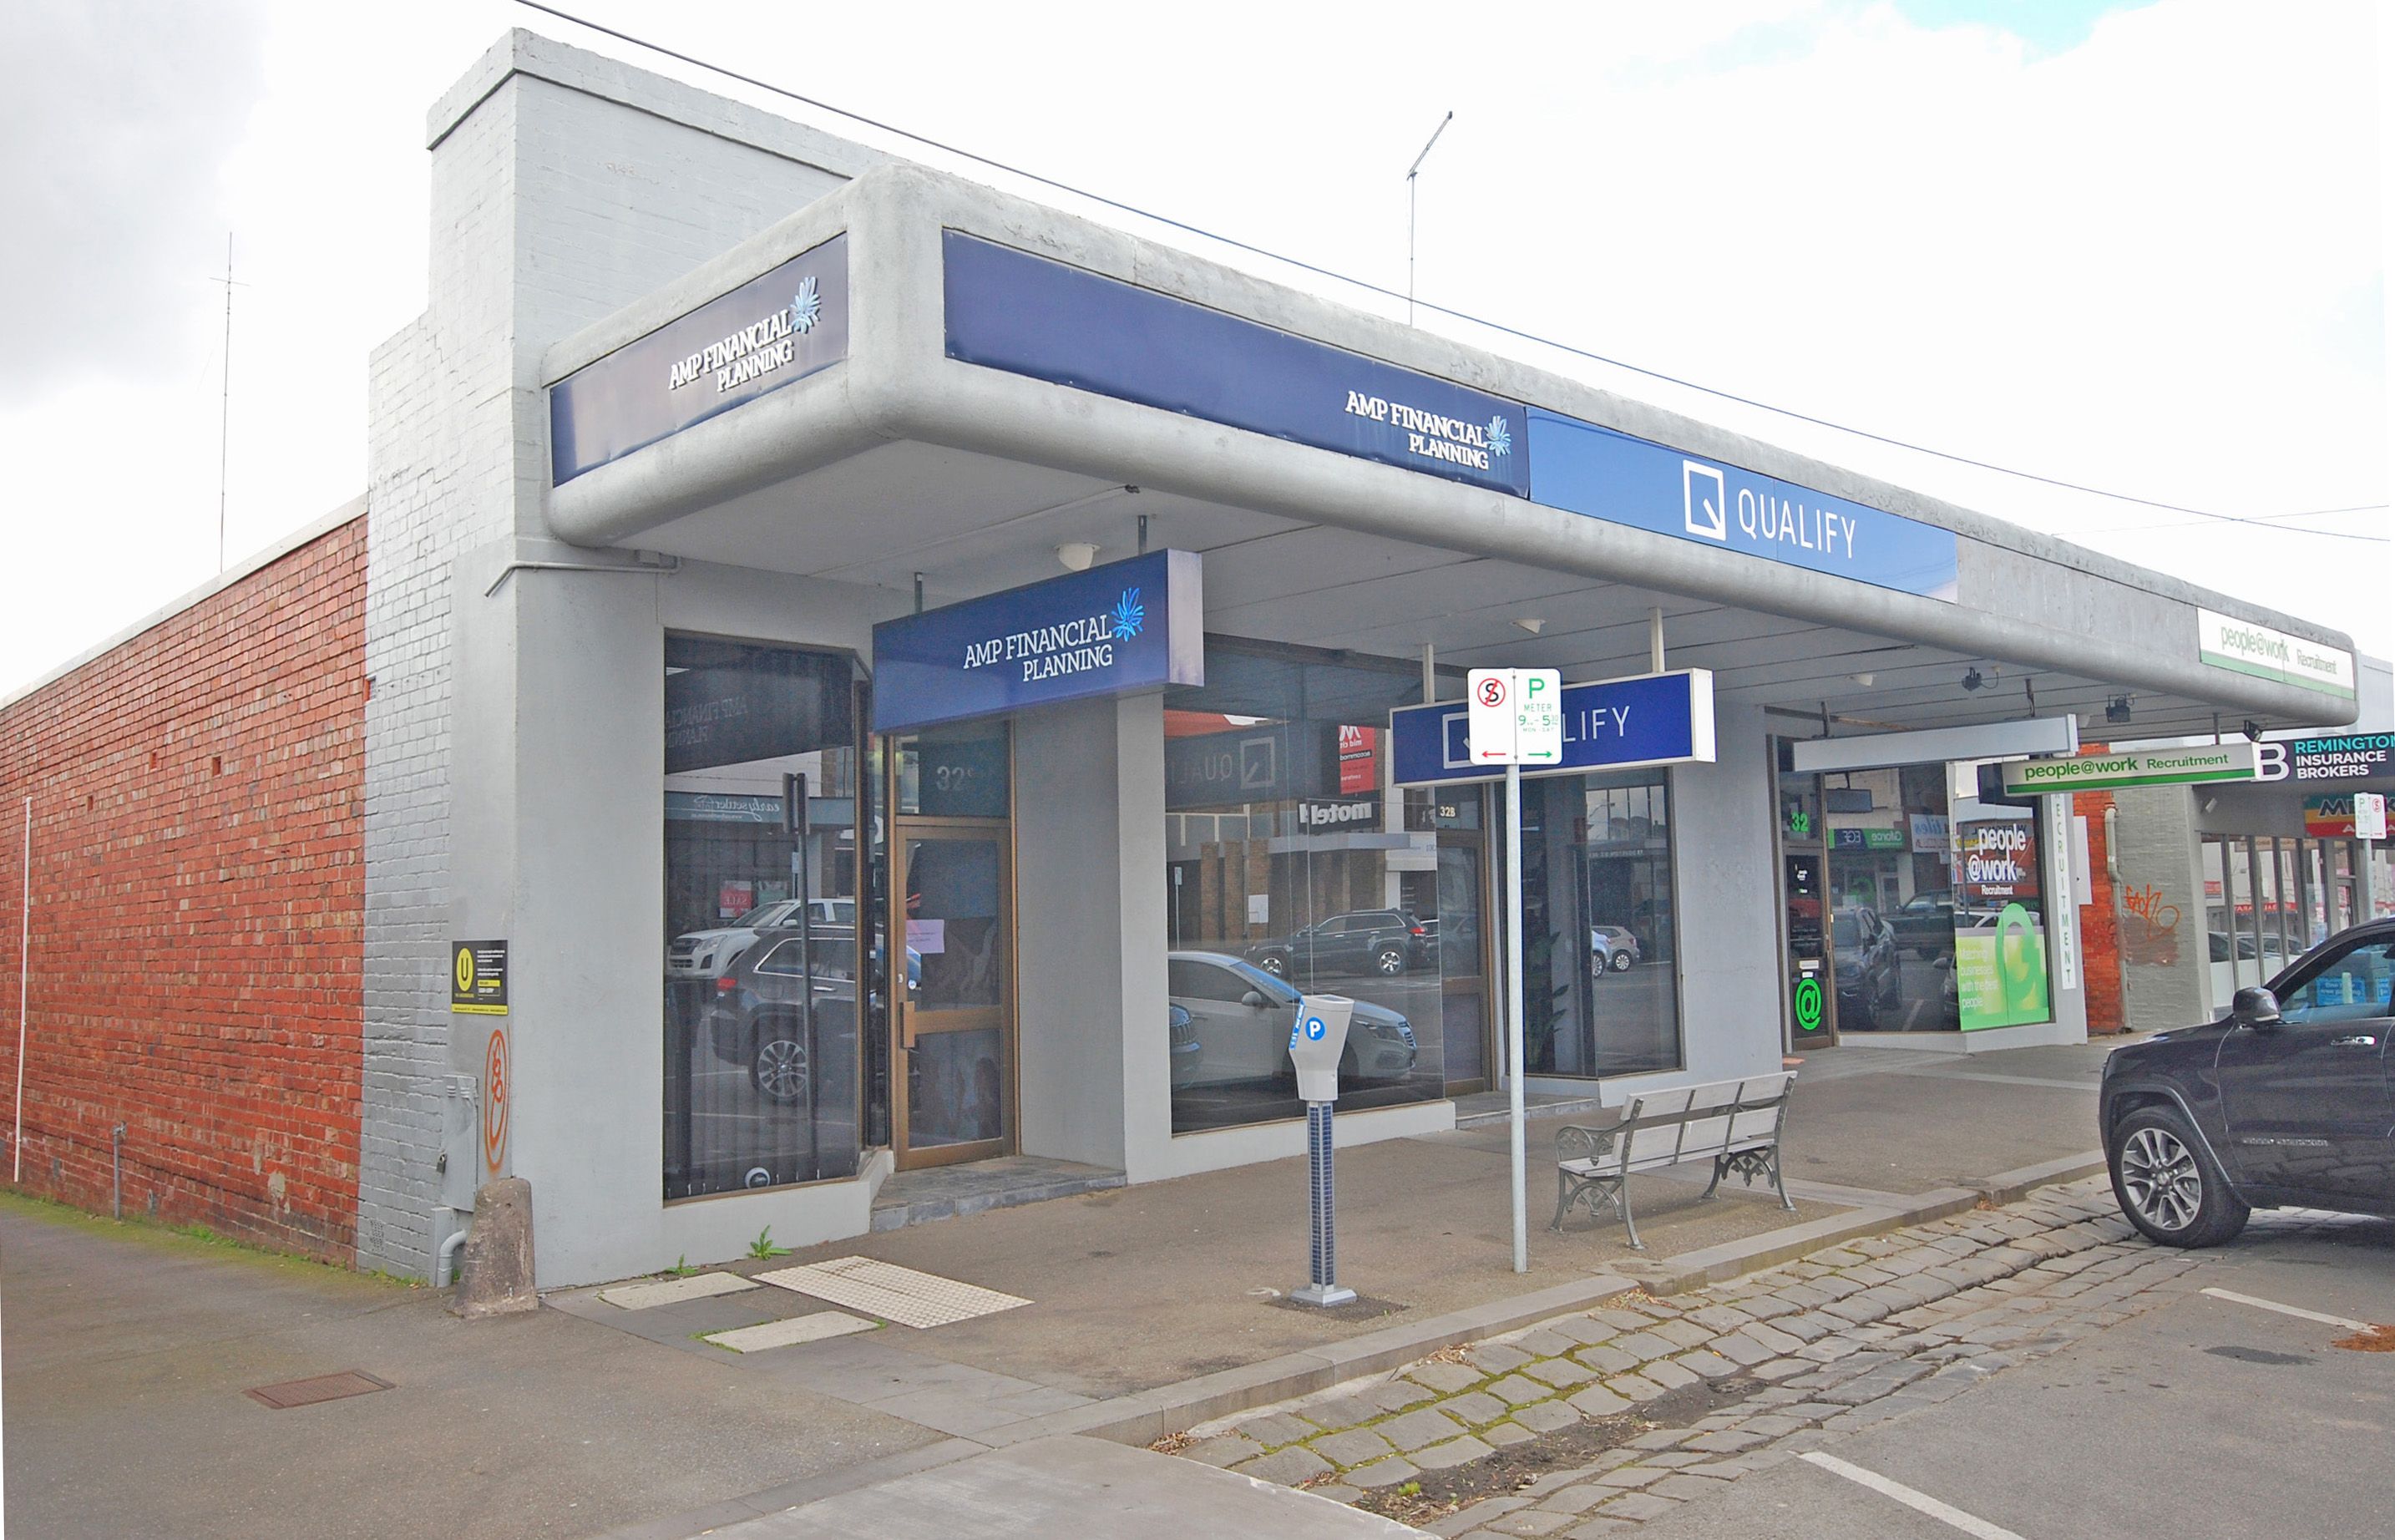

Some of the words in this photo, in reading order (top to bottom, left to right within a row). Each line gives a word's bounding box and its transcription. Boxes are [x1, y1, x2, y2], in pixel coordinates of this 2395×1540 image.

[668, 353, 703, 390] AMP
[702, 309, 792, 373] FINANCIAL
[716, 339, 793, 392] PLANNING
[1344, 390, 1388, 421] AMP
[1390, 403, 1488, 448] FINANCIAL
[1408, 433, 1489, 470] PLANNING
[1738, 488, 1856, 559] QUALIFY
[963, 639, 1003, 670] AMP
[1005, 615, 1112, 660] FINANCIAL
[2220, 626, 2290, 662] people@work
[2296, 648, 2337, 675] Recruitment
[1022, 643, 1113, 681] PLANNING
[1528, 678, 1545, 699] P
[1524, 703, 1552, 712] METER
[1562, 706, 1631, 742] LIFY
[2025, 757, 2138, 781] people@work
[2147, 753, 2229, 770] Recruitment
[2296, 750, 2387, 767] INSURANCE
[2296, 764, 2369, 779] BROKERS
[1791, 812, 1809, 832] 32
[1978, 823, 2027, 856] people
[1967, 852, 2018, 882] @work
[1981, 884, 2013, 895] Recruitment
[1309, 1021, 1321, 1037] P
